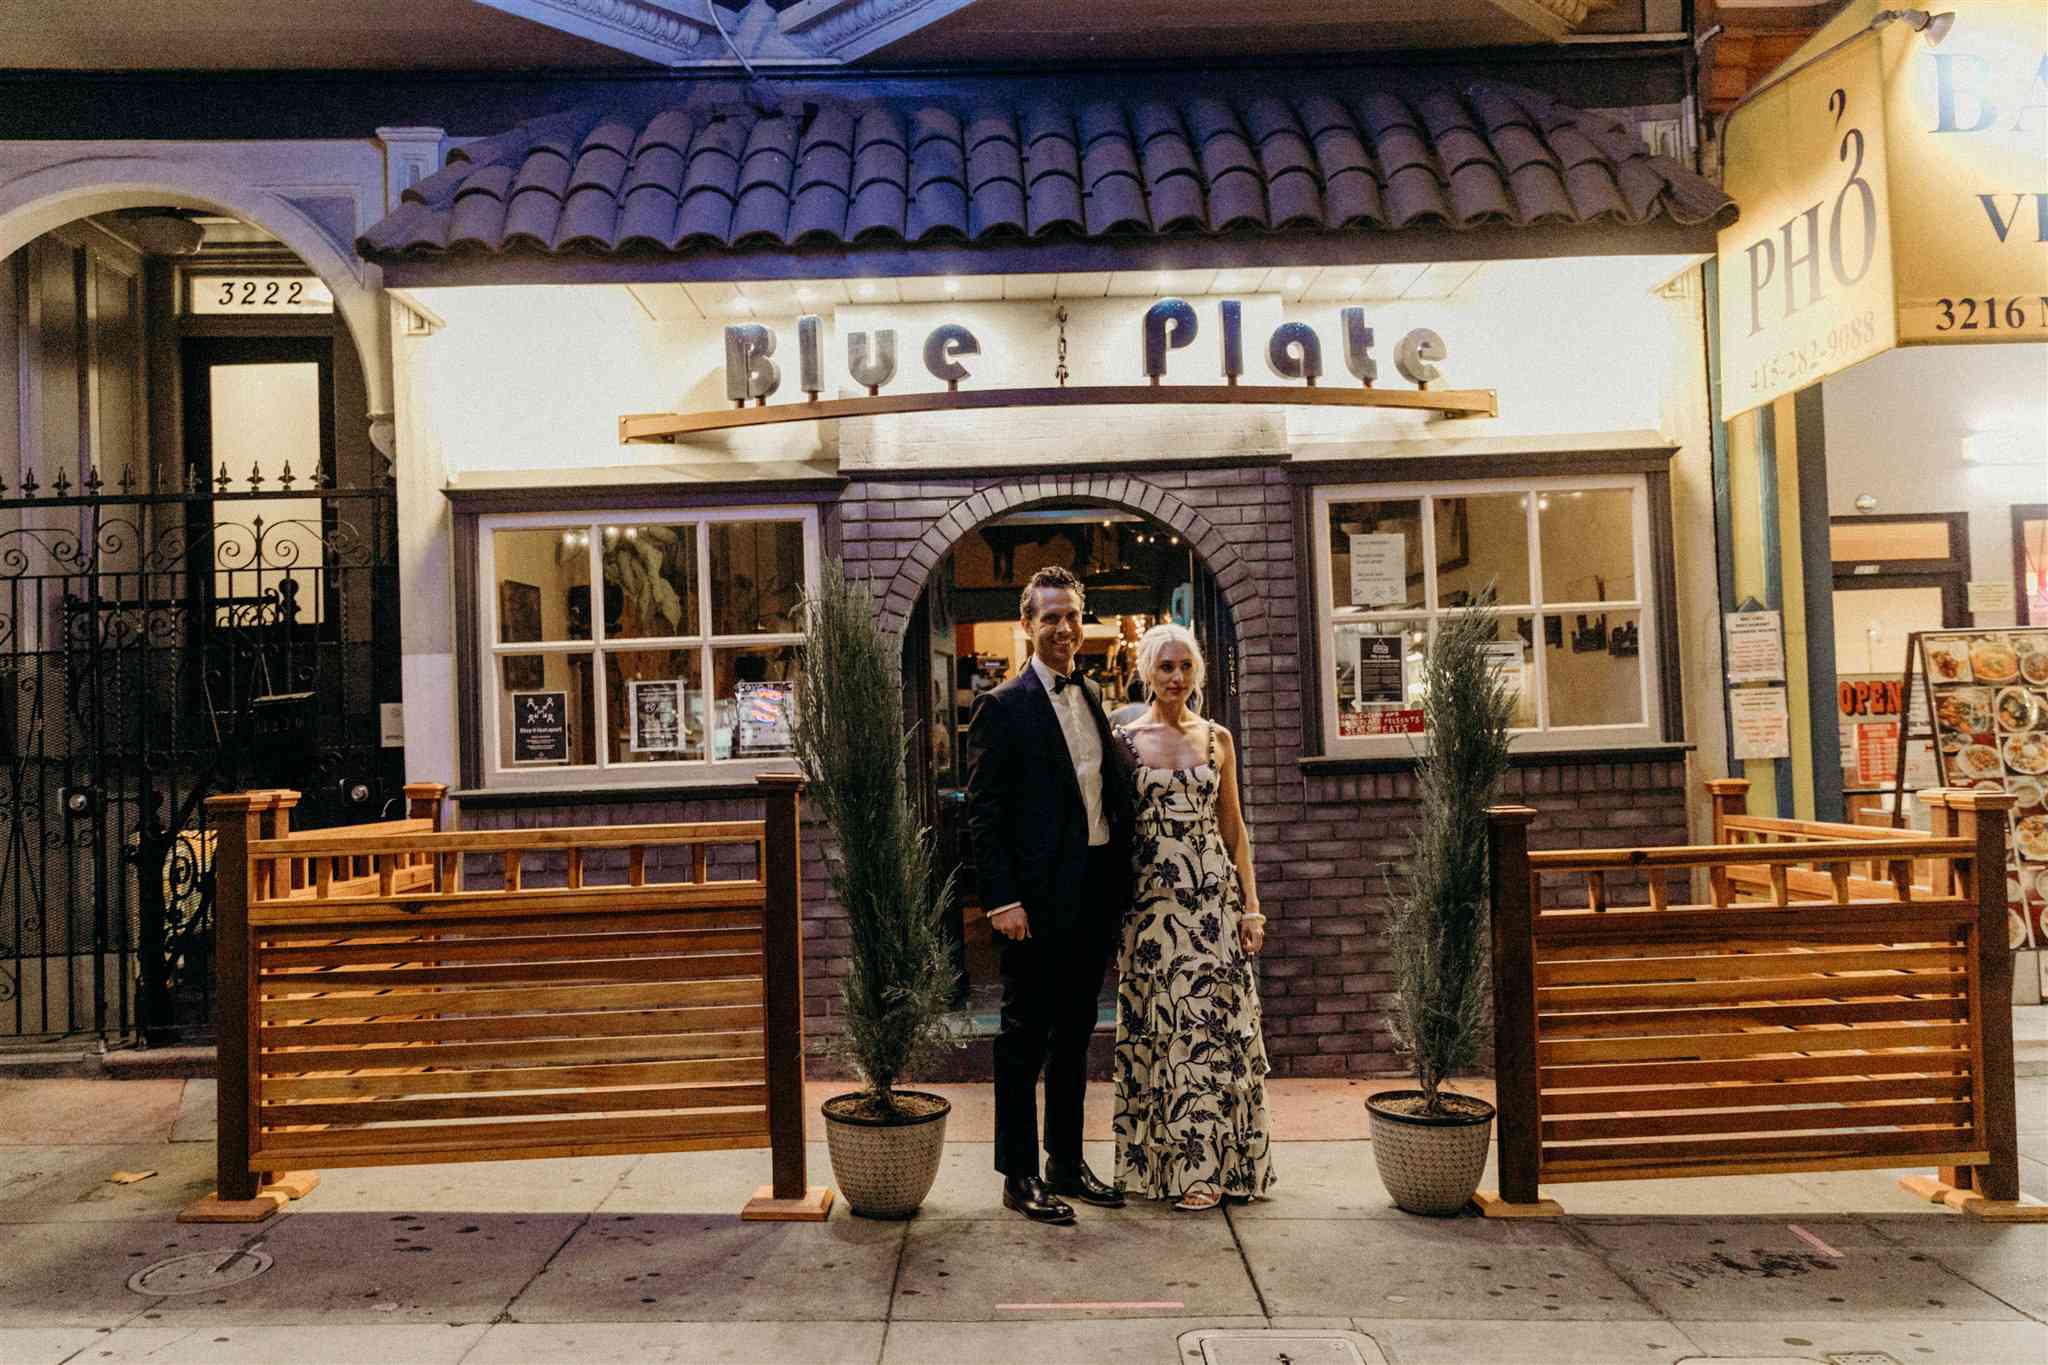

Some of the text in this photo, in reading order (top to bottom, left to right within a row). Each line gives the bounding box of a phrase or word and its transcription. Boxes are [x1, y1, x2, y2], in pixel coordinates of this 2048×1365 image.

[218, 281, 303, 305] 3222
[1935, 296, 2026, 331] 3216
[724, 297, 1447, 400] Blue Plate
[1840, 681, 1904, 716] OPEN
